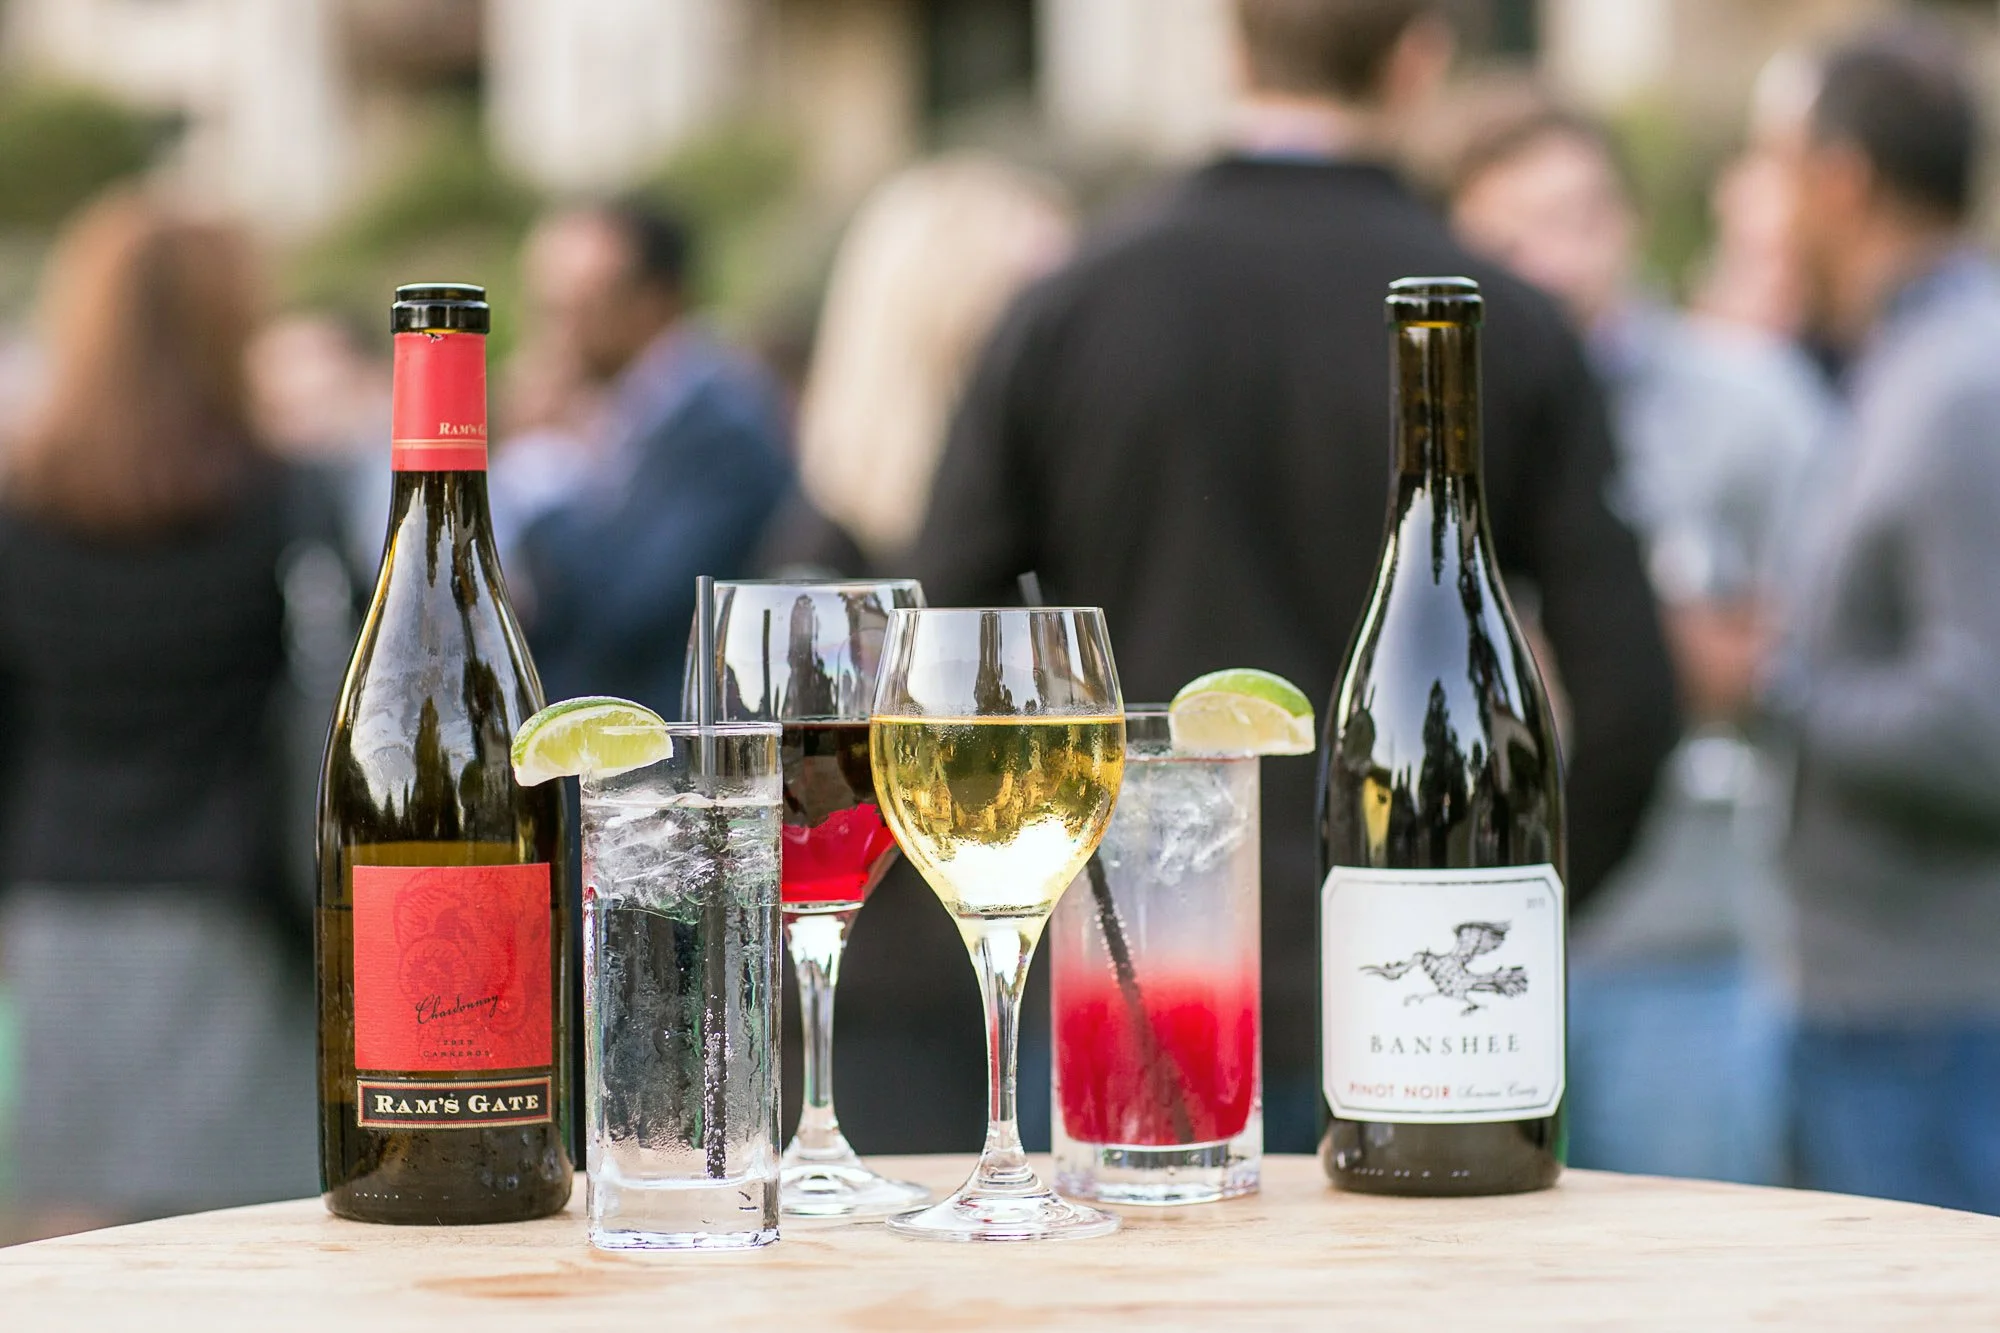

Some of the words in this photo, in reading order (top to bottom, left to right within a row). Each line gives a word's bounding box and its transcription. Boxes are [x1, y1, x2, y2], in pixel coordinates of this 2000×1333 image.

[415, 994, 499, 1025] Chardonnay
[1370, 1033, 1521, 1055] BANSHEE
[1349, 1081, 1395, 1098] PINOT
[1404, 1084, 1450, 1099] NOIR
[374, 1094, 460, 1114] RAM'S
[467, 1094, 539, 1114] GATE
